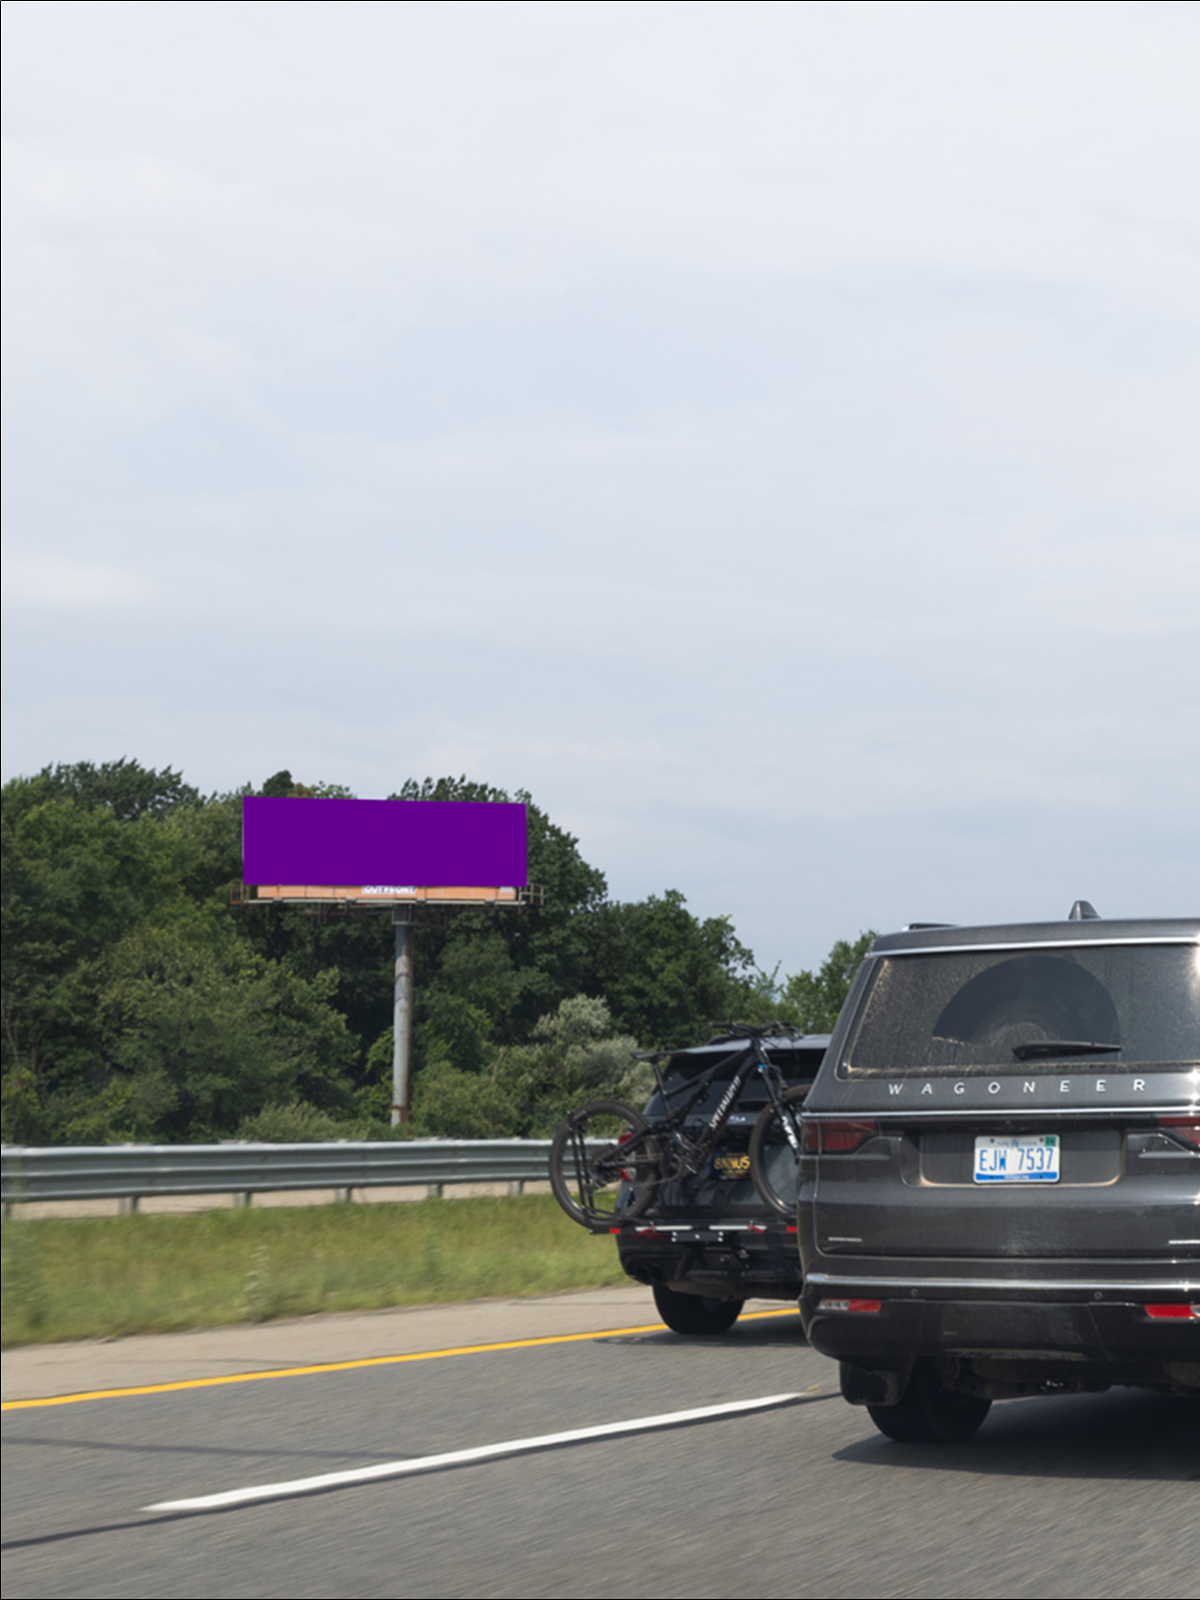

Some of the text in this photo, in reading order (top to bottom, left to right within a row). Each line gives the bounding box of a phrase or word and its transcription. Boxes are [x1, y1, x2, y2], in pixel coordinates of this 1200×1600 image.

[887, 1078, 1146, 1095] WAGONEER
[979, 1148, 1054, 1171] EJW 7537
